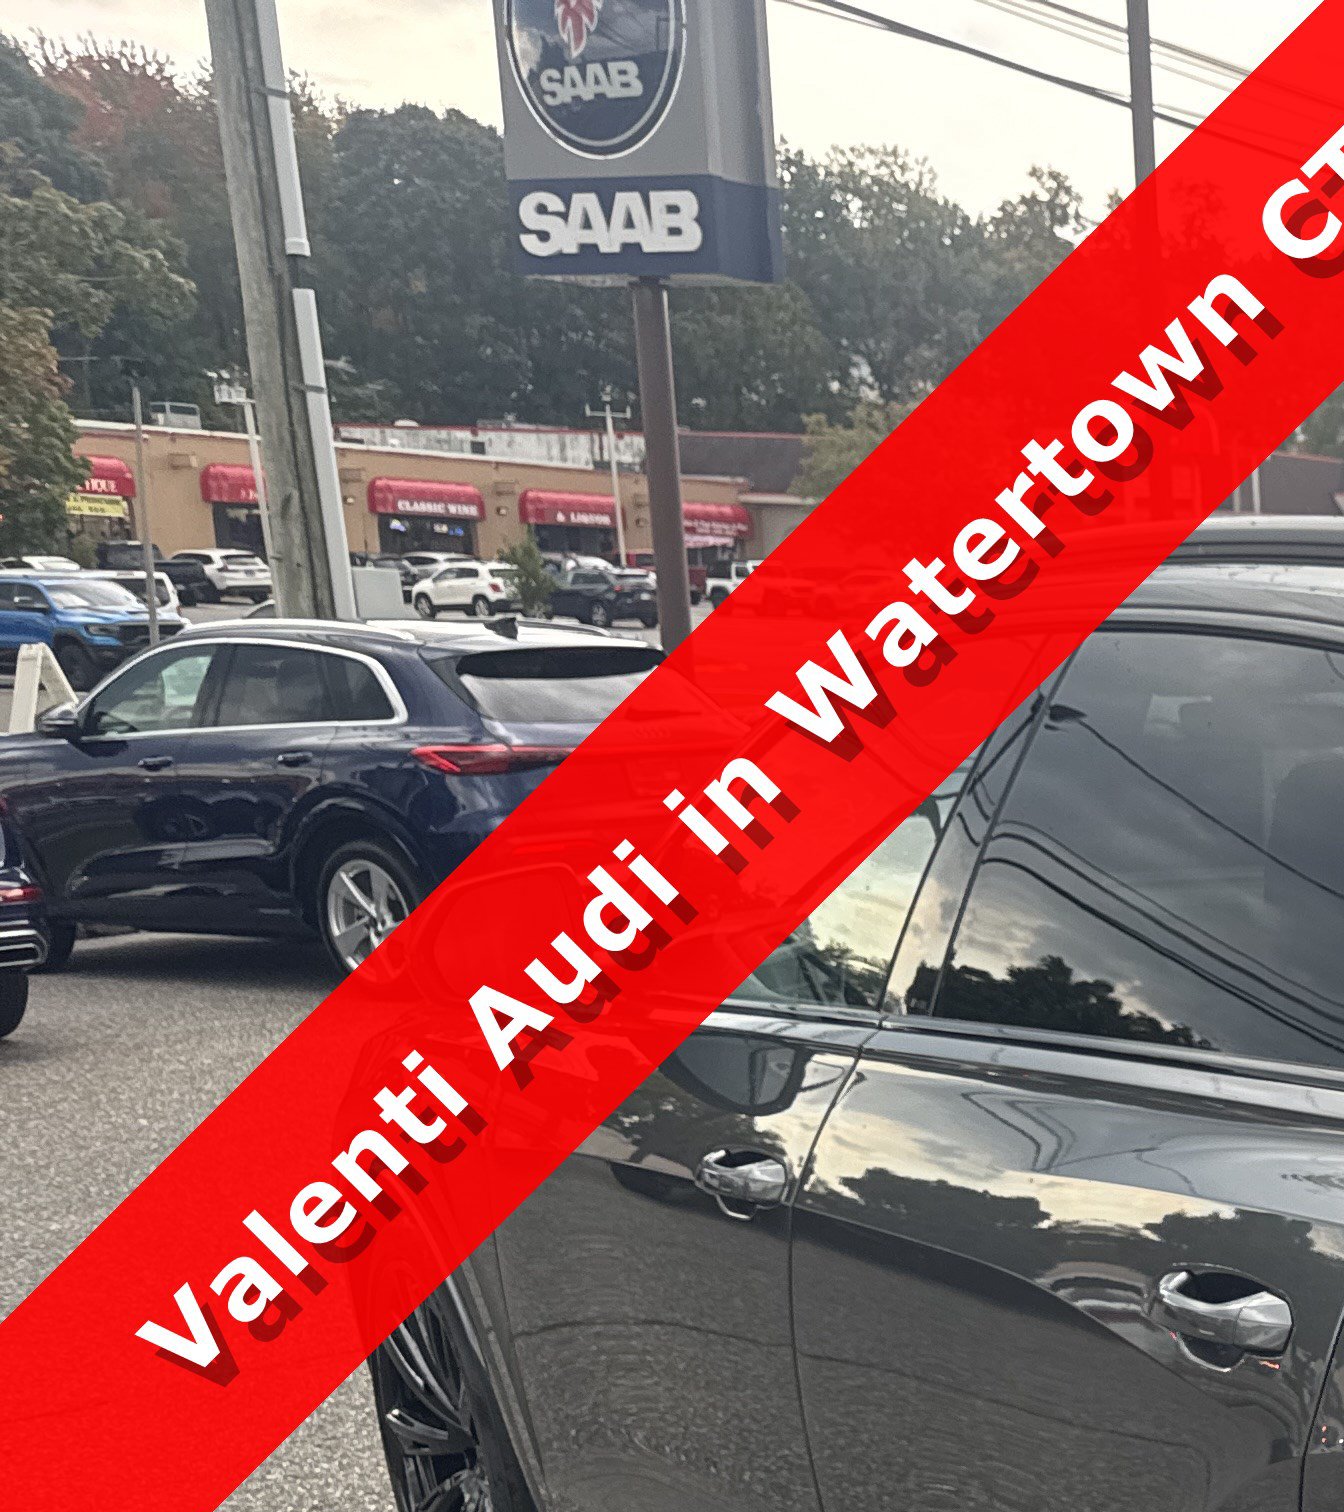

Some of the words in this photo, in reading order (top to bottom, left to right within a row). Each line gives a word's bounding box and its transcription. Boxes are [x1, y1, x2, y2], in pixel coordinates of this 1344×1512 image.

[540, 60, 643, 106] SAAB
[519, 190, 702, 257] SAAB
[397, 499, 446, 514] CLASSIC
[447, 502, 478, 517] WINE
